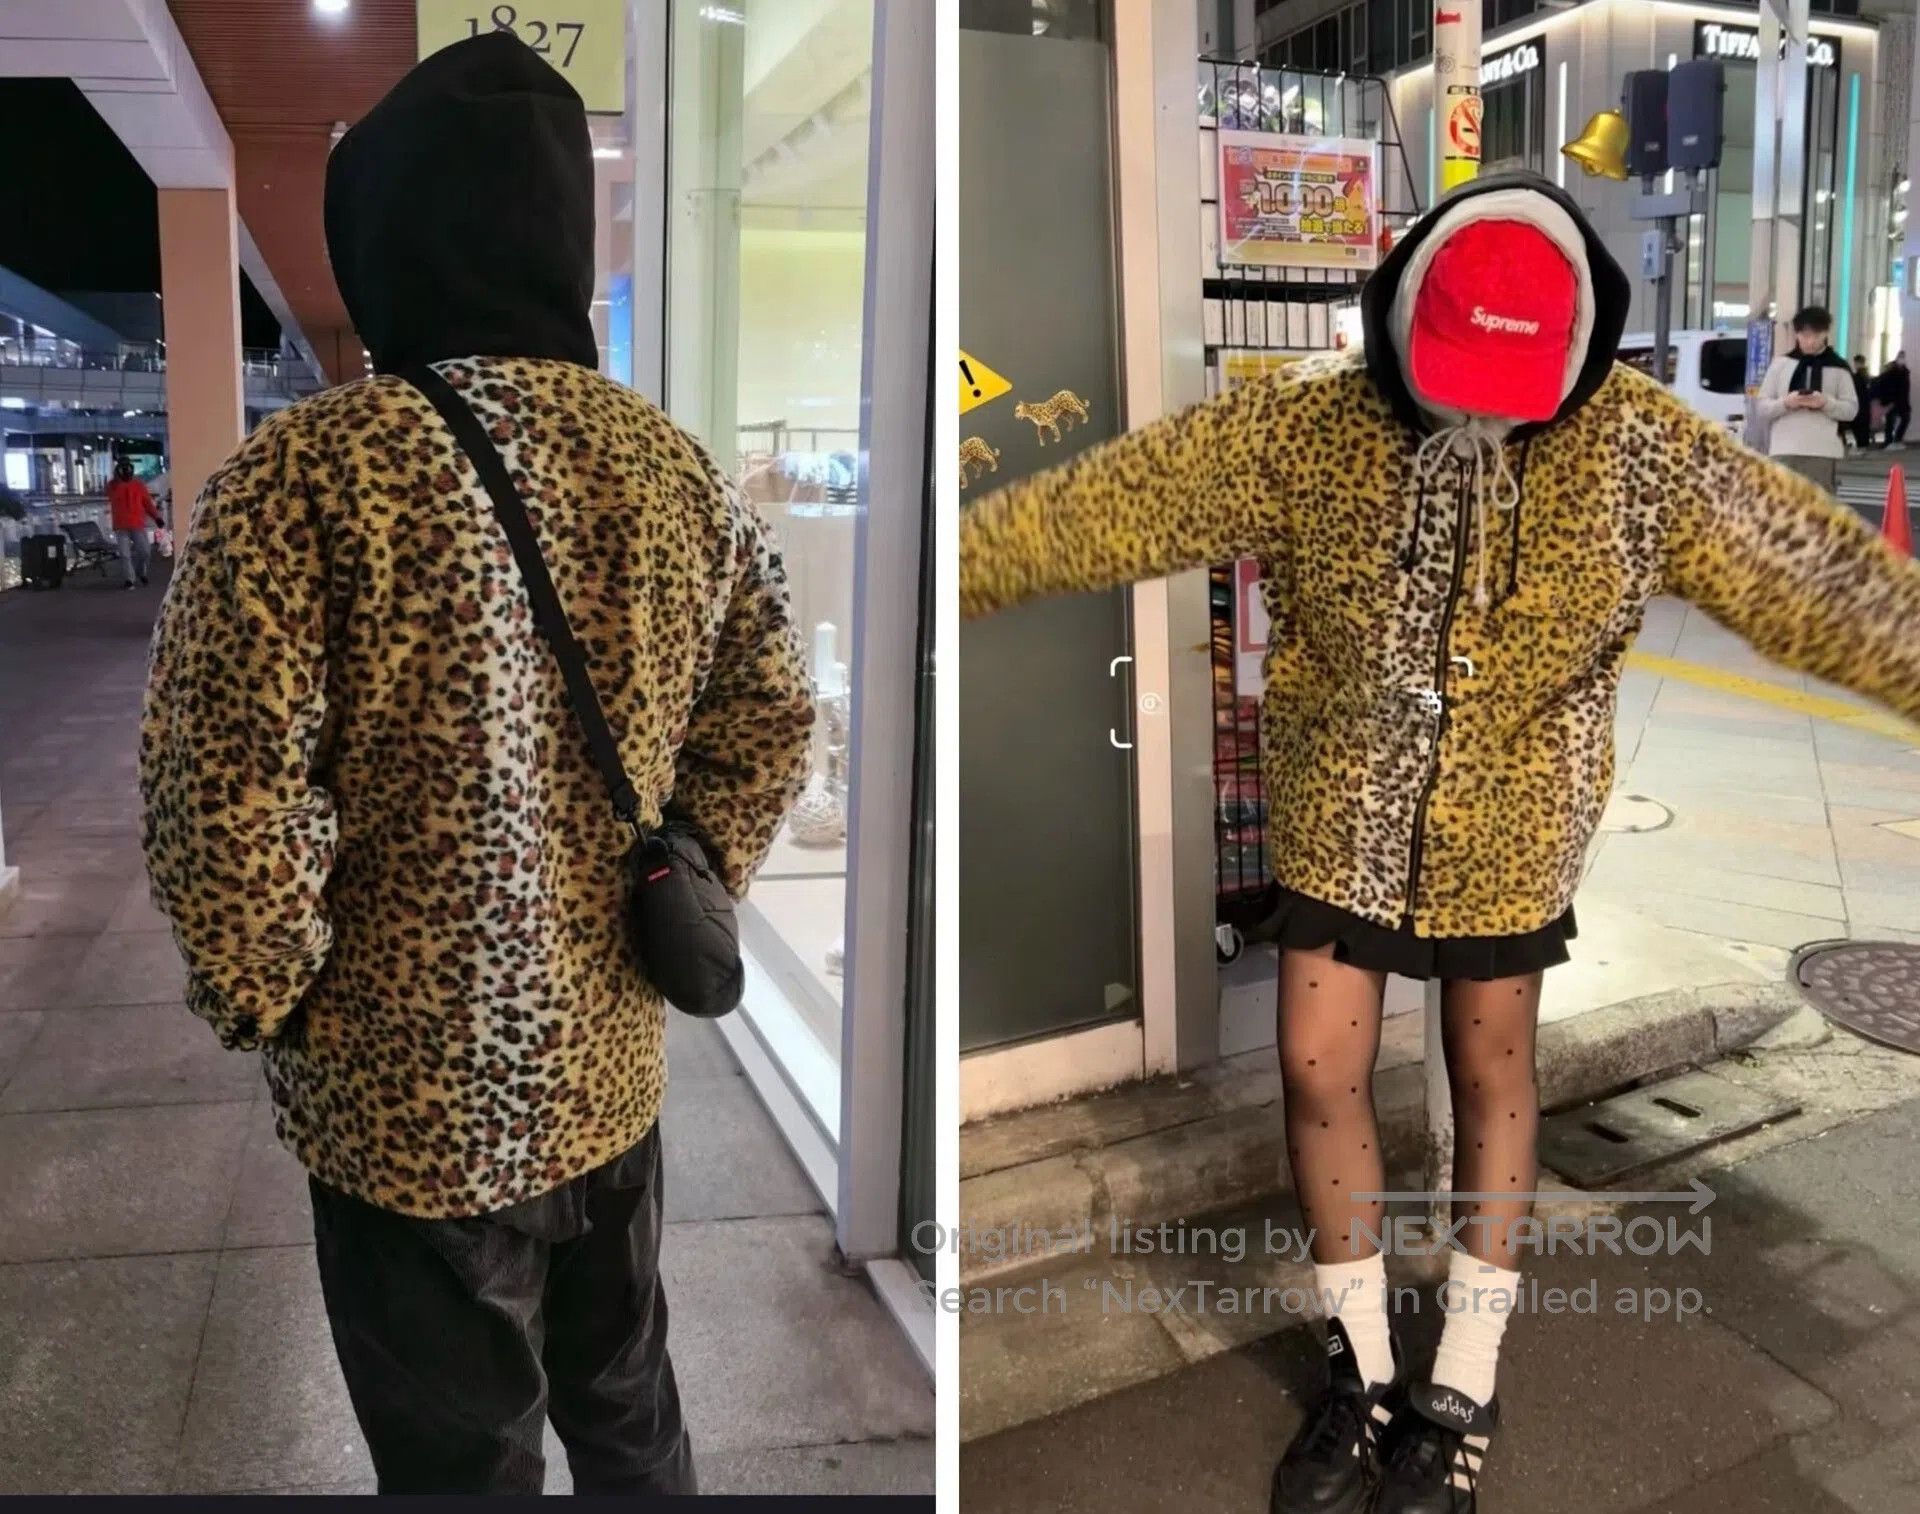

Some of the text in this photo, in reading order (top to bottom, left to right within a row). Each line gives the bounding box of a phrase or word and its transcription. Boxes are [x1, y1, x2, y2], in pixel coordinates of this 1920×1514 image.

[465, 5, 585, 68] 1827
[1703, 24, 1761, 58] TIFFA
[1470, 305, 1540, 336] Supreme
[1432, 1395, 1475, 1424] adidas
